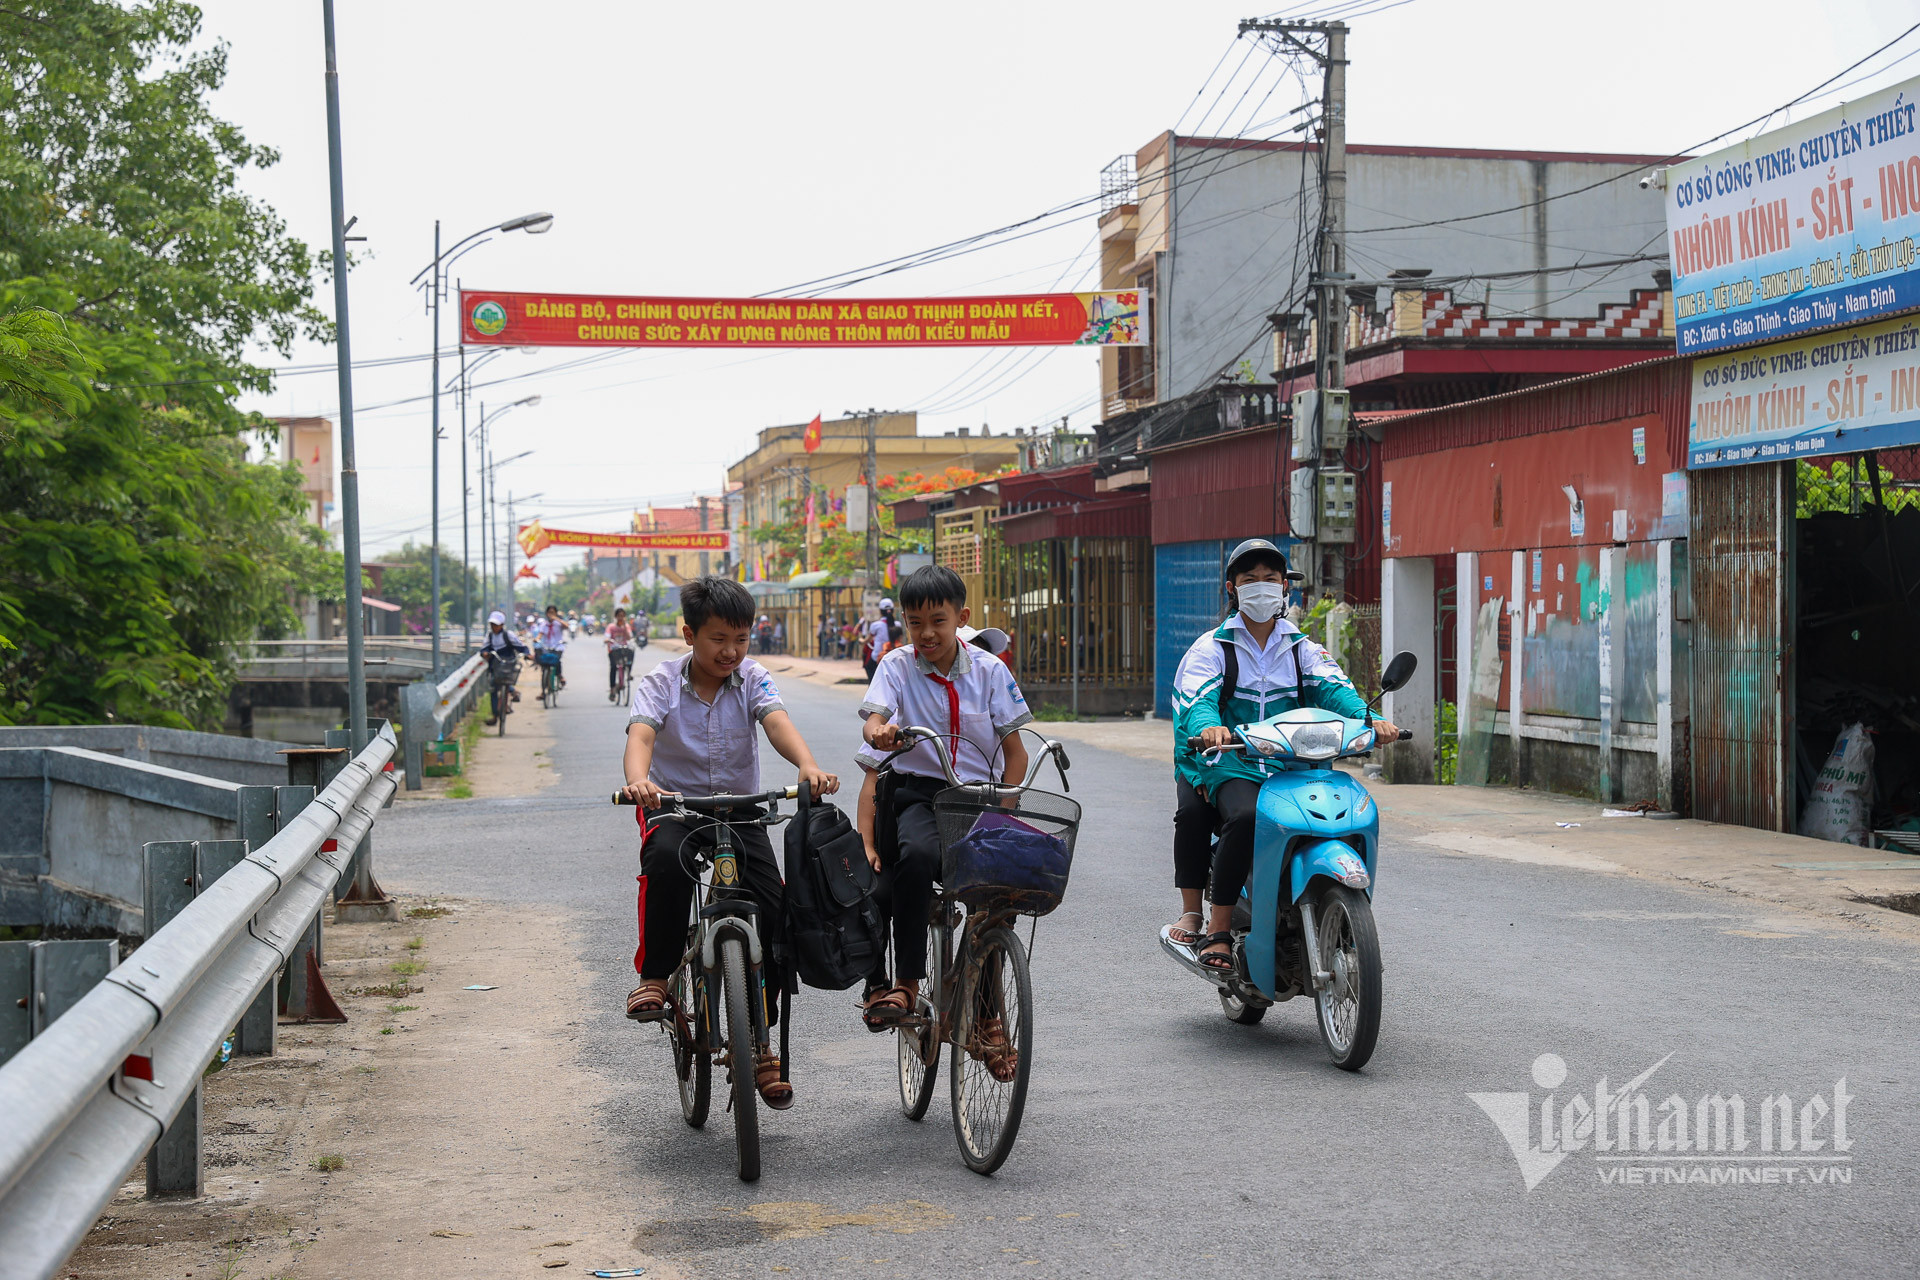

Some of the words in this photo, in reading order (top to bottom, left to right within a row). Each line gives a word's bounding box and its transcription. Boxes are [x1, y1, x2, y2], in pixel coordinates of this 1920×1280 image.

[1676, 175, 1693, 209] CƠ
[1696, 164, 1712, 203] SỞ
[1716, 160, 1753, 197] CÔNG
[1755, 147, 1796, 184] VINH:
[1799, 118, 1862, 169] CHUYÊN
[1865, 92, 1916, 147] THIẾT
[1673, 212, 1734, 278] NHÔM
[1737, 197, 1791, 261] KÍNH
[1810, 165, 1854, 241] SẮT
[1676, 293, 1696, 319] XING
[1696, 290, 1708, 314] FA
[1712, 281, 1730, 314] VIỆT
[1731, 276, 1754, 307] PHÁP
[1761, 271, 1789, 301] ZHONG
[1789, 267, 1805, 294] KAI
[1810, 257, 1835, 288] ĐÔNG
[1836, 252, 1844, 282] Á
[1850, 244, 1870, 279] CỬA
[1870, 237, 1894, 274] THỦY
[1895, 236, 1915, 271] LỰC
[525, 298, 576, 318] ĐẢNG
[580, 301, 612, 321] BỘ,
[616, 301, 672, 319] CHÍNH
[741, 303, 791, 320] NHÂN
[796, 303, 833, 320] DÂN
[838, 303, 862, 320] XÃ
[866, 304, 908, 320] GIAO
[912, 304, 965, 322] THỊNH
[969, 301, 1017, 319] ĐOÀN
[1022, 298, 1059, 319] KẾT,
[578, 324, 640, 340] CHUNG
[645, 322, 681, 340] SỨC
[686, 323, 721, 341] XÂY
[726, 325, 775, 344] DỰNG
[780, 323, 831, 341] NÔNG
[835, 323, 882, 341] THÔN
[886, 322, 921, 340] MỚI
[925, 320, 966, 340] KIỂU
[970, 319, 1010, 339] MẪU
[1683, 328, 1699, 347] ĐC:
[1700, 324, 1719, 343] Xóm
[1720, 322, 1726, 339] 6
[1733, 318, 1754, 337] Giao
[1755, 311, 1781, 334] Thịnh
[1788, 305, 1811, 325] Giao
[1812, 297, 1837, 321] Thủy
[1845, 294, 1869, 313] Nam
[1871, 284, 1896, 310] Định
[1703, 365, 1720, 388] CƠ
[1721, 356, 1738, 385] SỞ
[1740, 354, 1767, 381] ĐỨC
[1770, 350, 1807, 375] VINH:
[1810, 333, 1871, 368] CHUYÊN
[1873, 322, 1920, 356] THIẾT
[1695, 391, 1751, 444] NHÔM
[1757, 382, 1806, 432] KÍNH
[1826, 363, 1868, 422] SẮT
[1726, 449, 1740, 460] Giao
[1761, 444, 1775, 456] Giao
[1776, 441, 1791, 455] Thủy
[1795, 439, 1810, 451] Nam
[1811, 436, 1825, 451] Định
[1820, 766, 1846, 781] PHÚ
